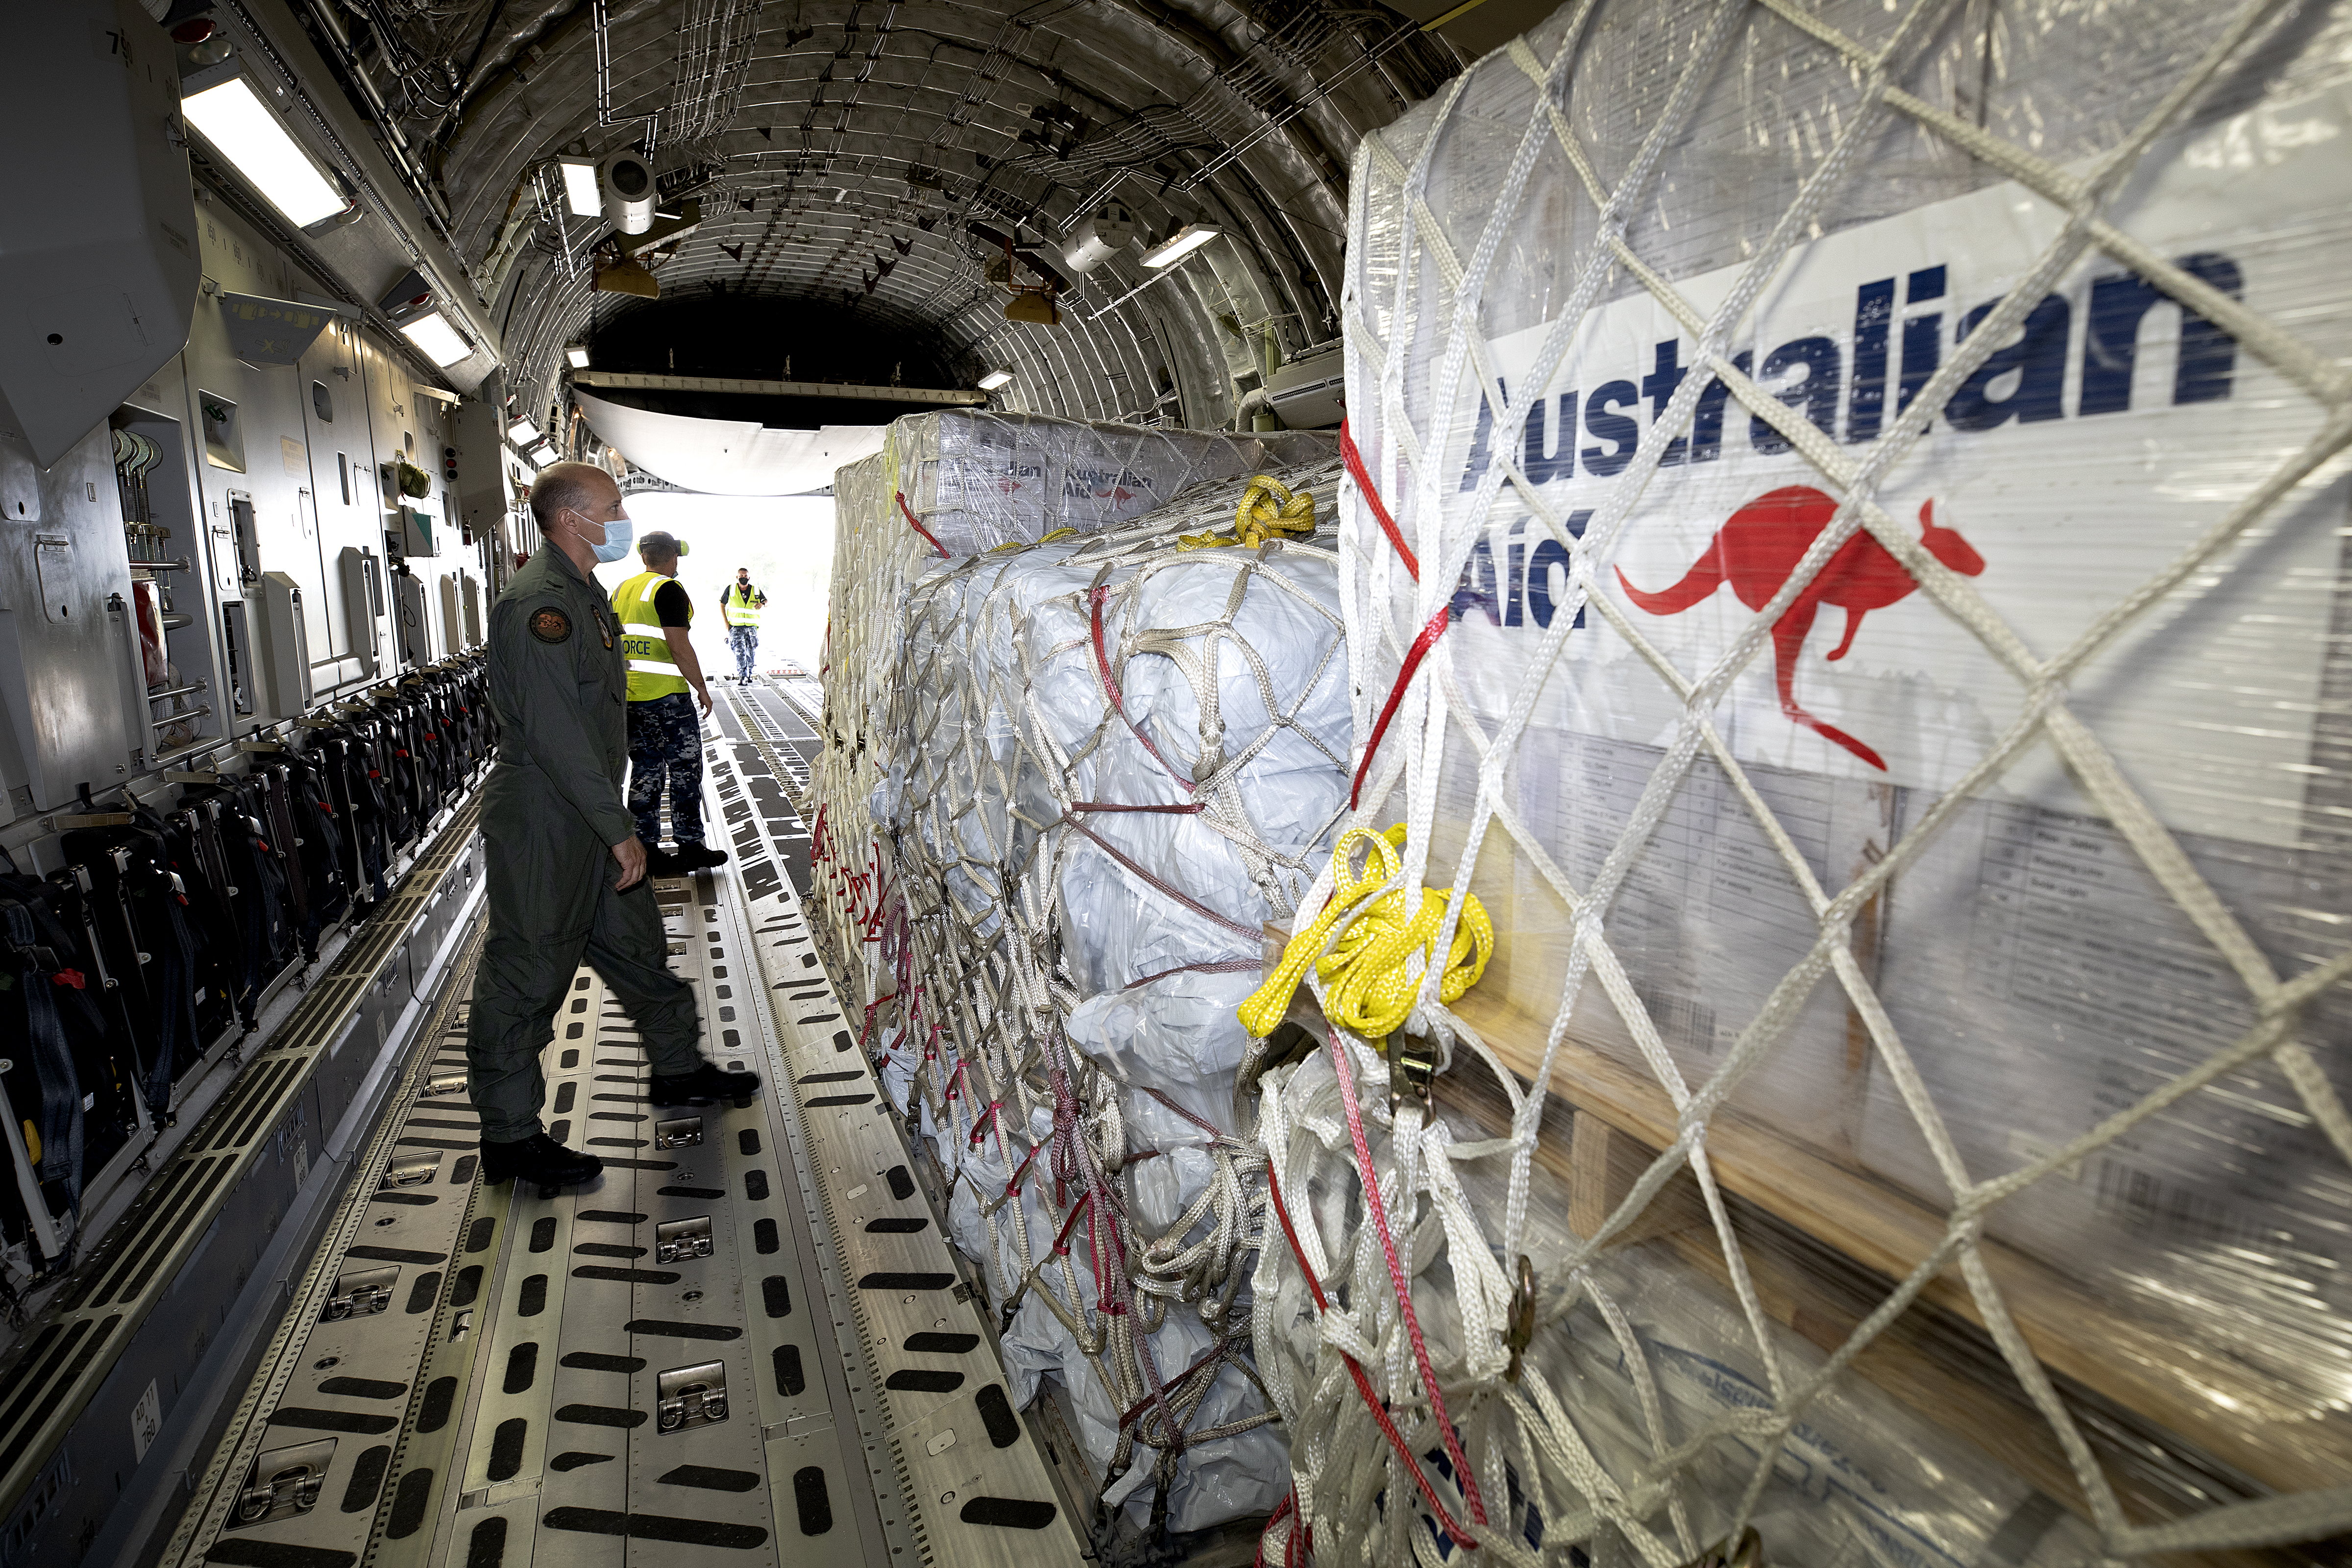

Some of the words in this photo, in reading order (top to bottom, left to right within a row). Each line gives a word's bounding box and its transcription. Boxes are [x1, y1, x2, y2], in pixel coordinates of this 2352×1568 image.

[105, 30, 132, 64] 790
[1458, 252, 2245, 493] Australian
[1063, 482, 1091, 499] Aid
[1065, 467, 1152, 489] Australian
[1072, 521, 1096, 532] HYGI
[1448, 509, 1596, 630] Aid
[622, 640, 651, 656] ORCE
[136, 1401, 145, 1425] AD
[147, 1386, 154, 1406] 11
[142, 1418, 155, 1449] 760
